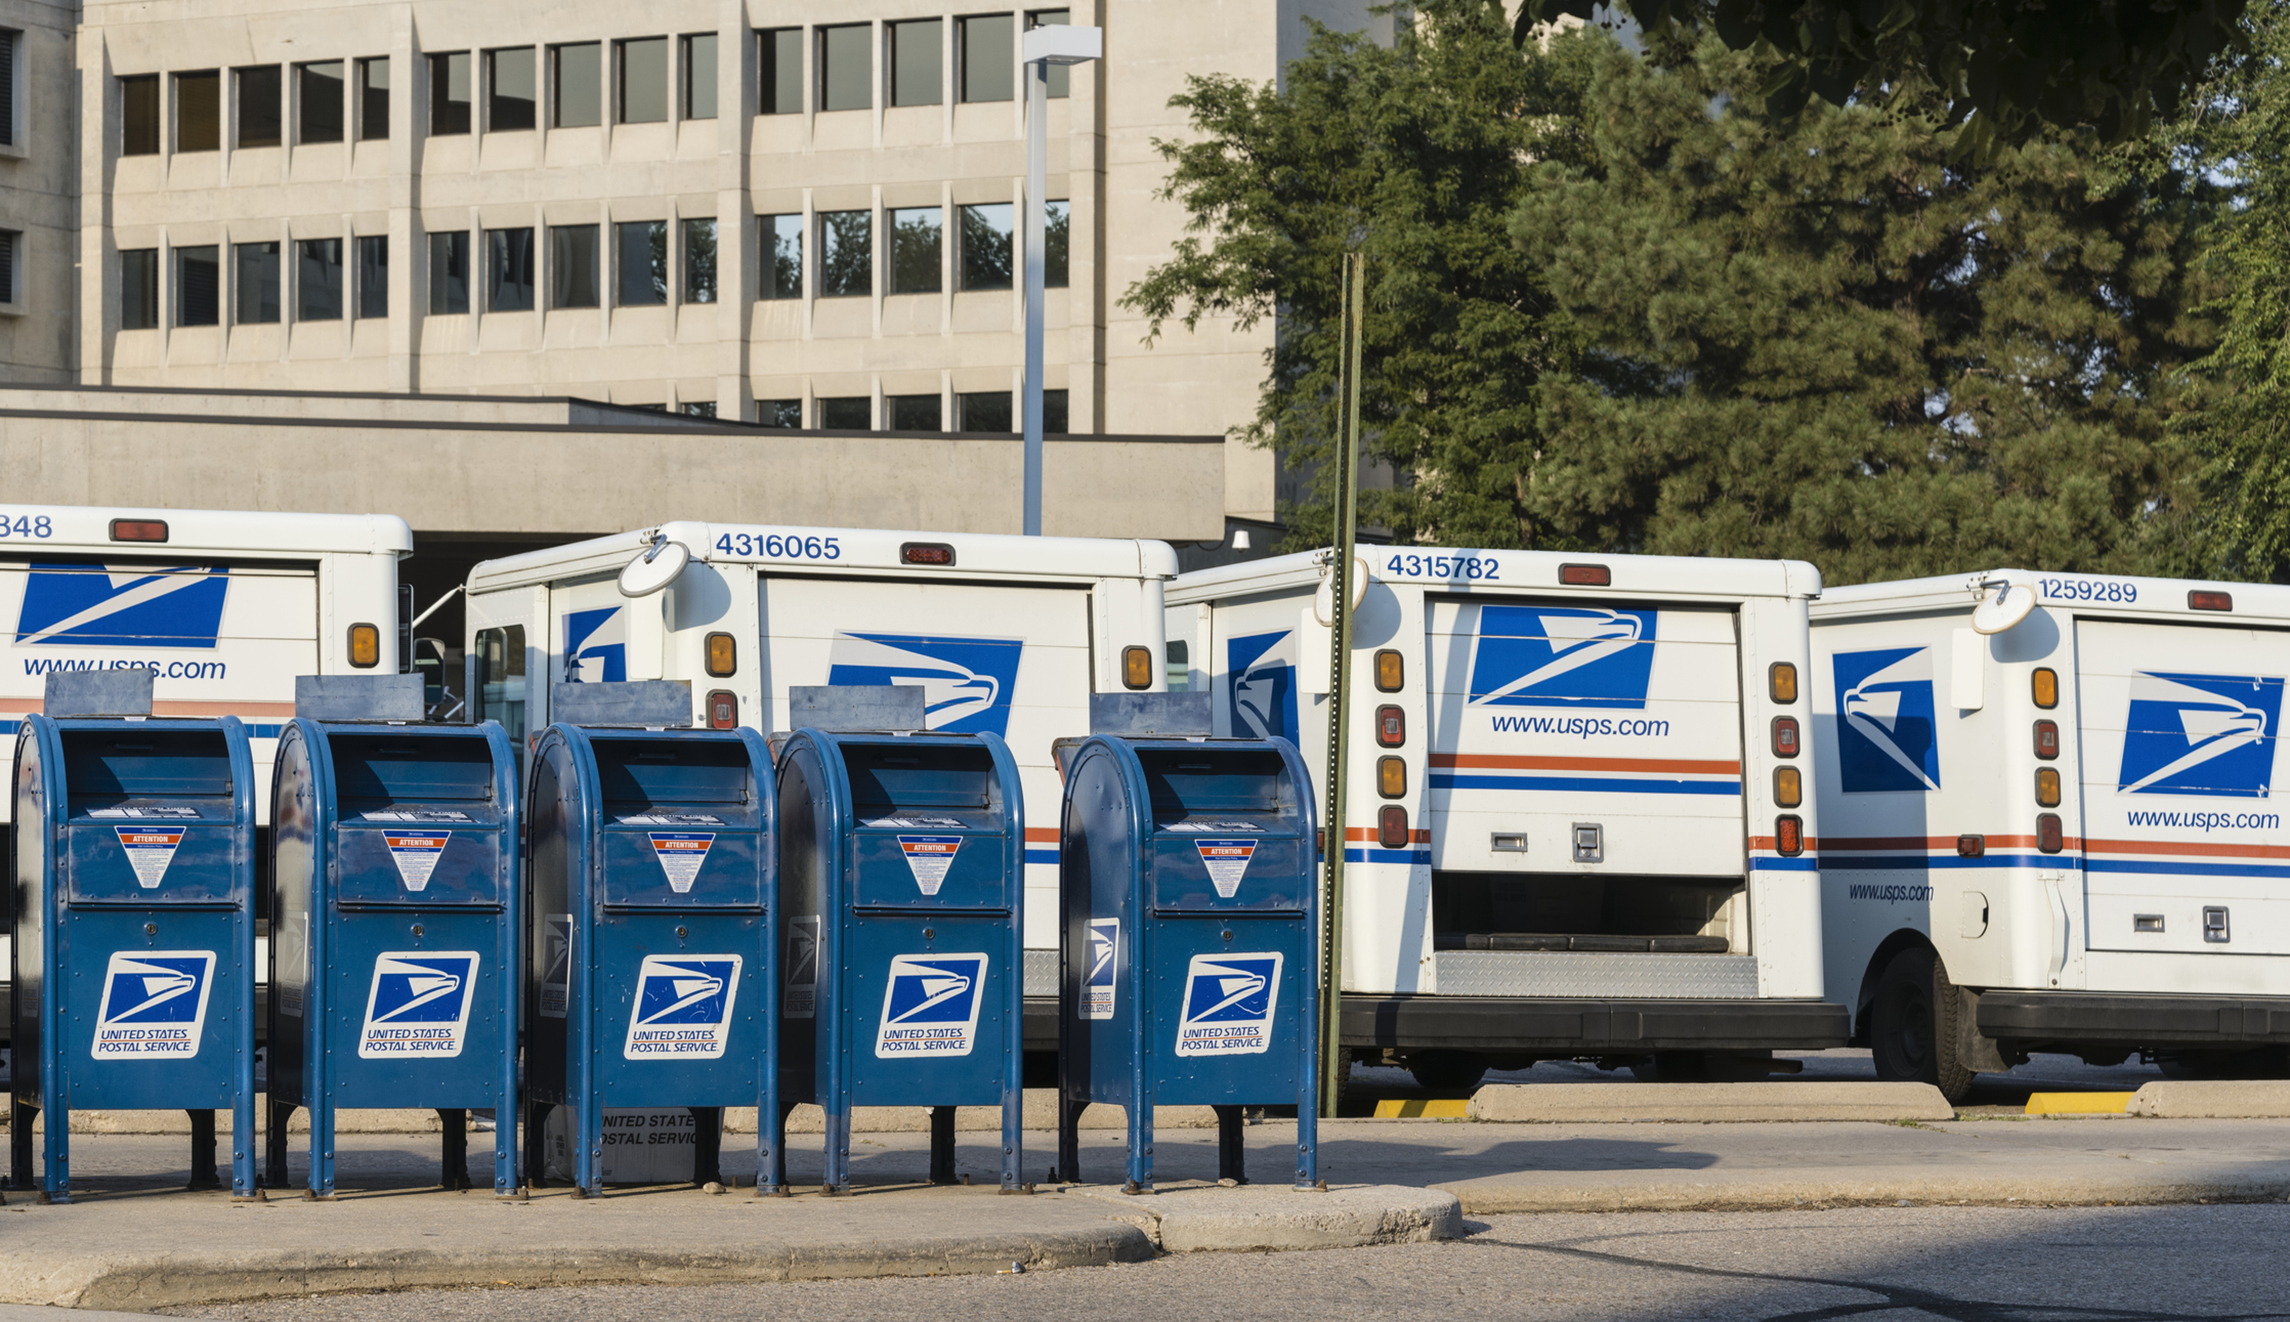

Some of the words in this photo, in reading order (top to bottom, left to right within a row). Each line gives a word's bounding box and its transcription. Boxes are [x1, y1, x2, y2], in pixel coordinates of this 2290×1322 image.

[716, 533, 840, 560] 4316065
[1387, 554, 1500, 580] 4315782
[2039, 578, 2137, 603] 1259289
[1491, 716, 1670, 739] www.usps.com
[2127, 811, 2280, 833] www.usps.com
[1849, 884, 1934, 905] www.usps.com
[101, 1030, 145, 1039] UNITED
[147, 1029, 187, 1039] STATES
[368, 1029, 411, 1039] UNITED
[412, 1029, 452, 1038] STATES
[633, 1031, 675, 1040] UNITED
[676, 1030, 715, 1040] STATES
[884, 1029, 924, 1039] UNITED
[926, 1028, 963, 1038] STATES
[1183, 1028, 1222, 1038] UNITED
[1224, 1026, 1259, 1036] STATES
[99, 1042, 142, 1052] POSTAL
[144, 1042, 191, 1051] SERVICE
[365, 1042, 407, 1051] POSTAL
[409, 1041, 455, 1051] SERVICE
[630, 1043, 671, 1052] POSTAL
[673, 1042, 718, 1052] SERVICE
[882, 1042, 921, 1051] POSTAL
[923, 1040, 966, 1050] SERVICE
[1181, 1040, 1219, 1050] POSTAL
[1221, 1038, 1263, 1048] SERVICE
[602, 1115, 645, 1127] NITED
[649, 1115, 694, 1127] STATE
[602, 1133, 643, 1144] OSTAL
[648, 1133, 696, 1144] SERVIC
